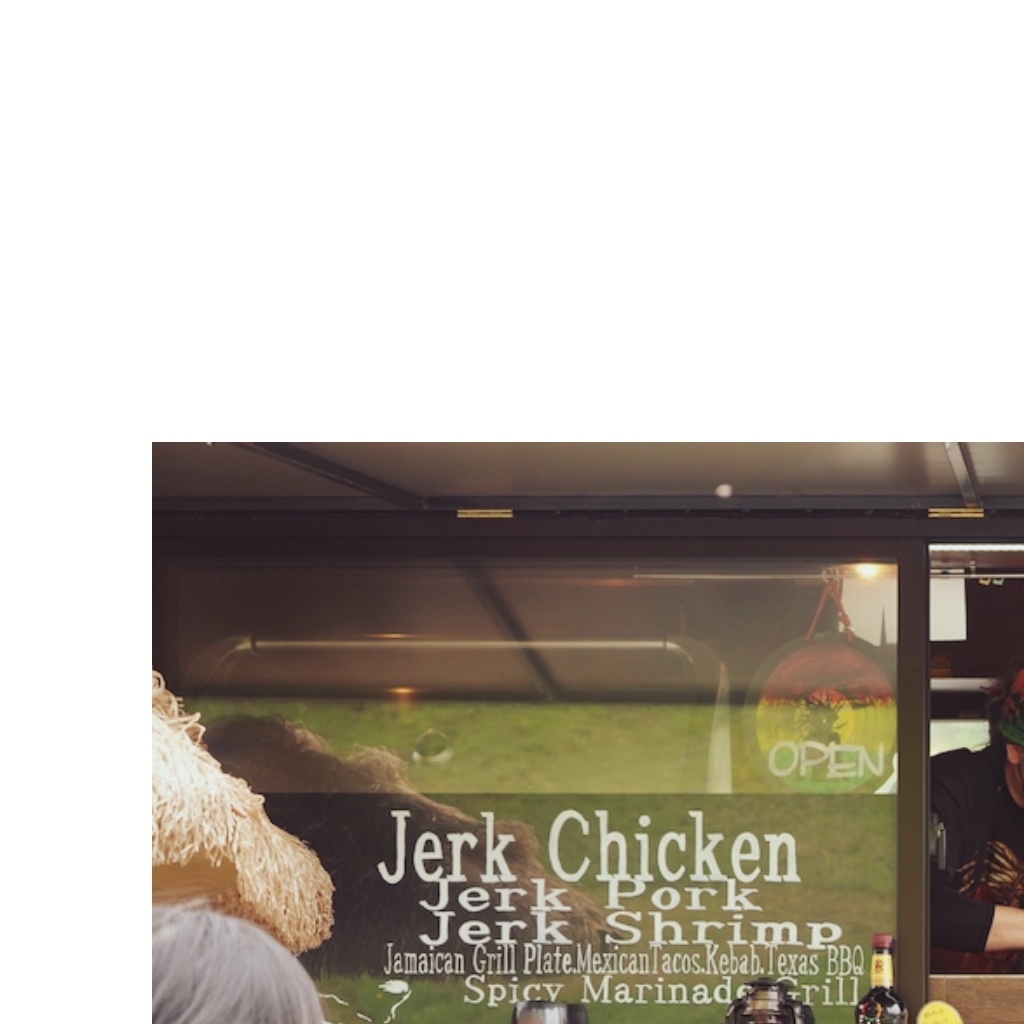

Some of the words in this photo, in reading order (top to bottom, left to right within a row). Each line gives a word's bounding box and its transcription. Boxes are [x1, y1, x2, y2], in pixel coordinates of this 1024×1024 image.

[768, 740, 885, 778] OPEN
[377, 809, 517, 883] Jerk
[548, 809, 802, 883] Chicken
[418, 878, 573, 912] Jerk
[604, 878, 763, 911] Pork
[418, 911, 573, 946] Jerk
[604, 911, 843, 950] Shrimp
[383, 943, 465, 976] Jamaican
[472, 943, 516, 976] Grill
[826, 945, 865, 977] BBQ
[463, 974, 565, 1008] Spicy
